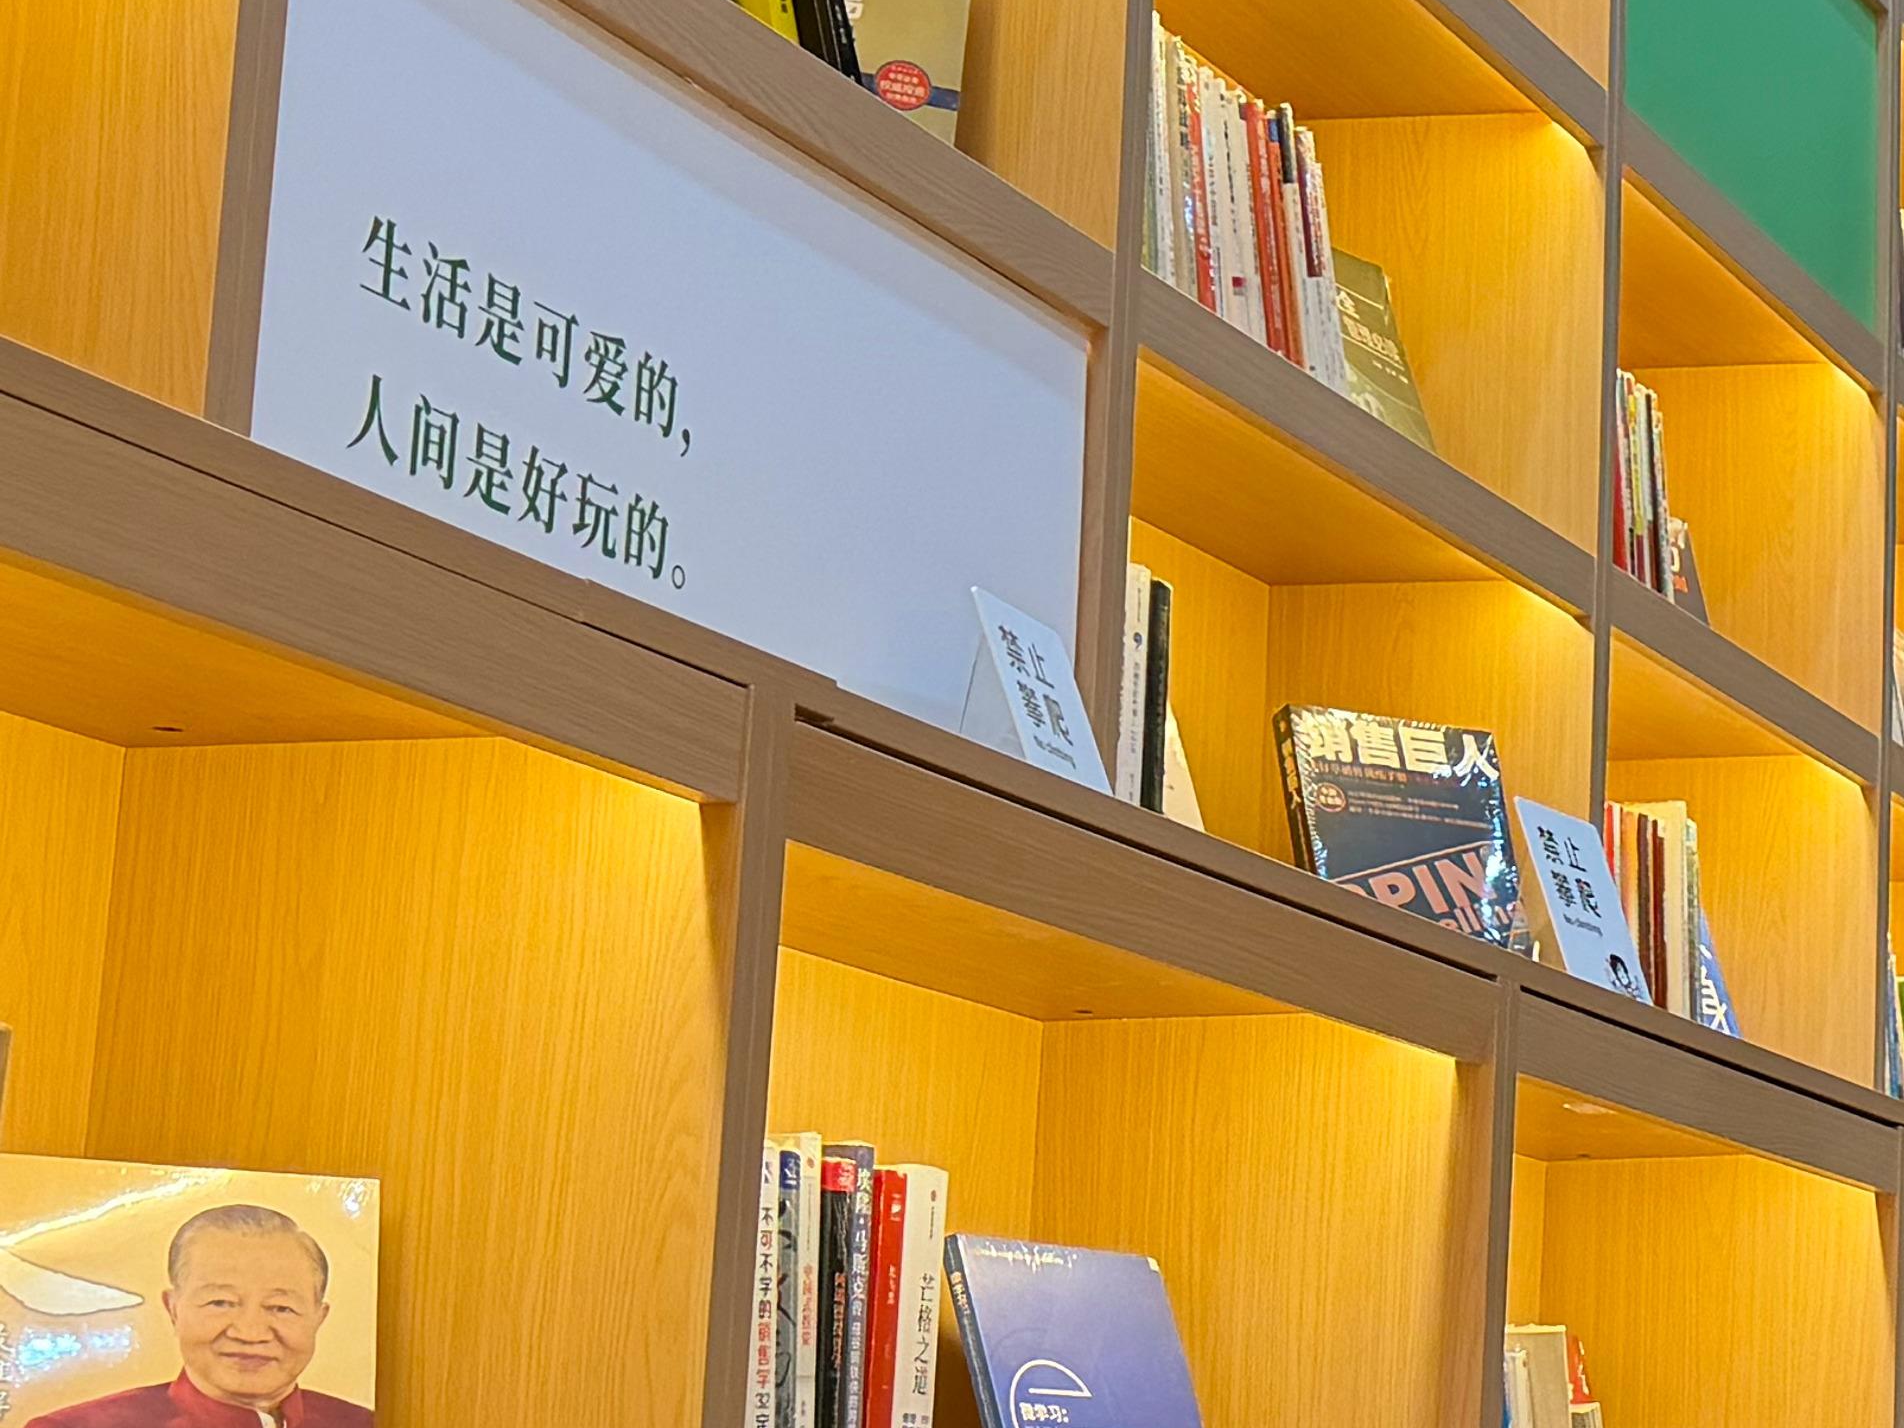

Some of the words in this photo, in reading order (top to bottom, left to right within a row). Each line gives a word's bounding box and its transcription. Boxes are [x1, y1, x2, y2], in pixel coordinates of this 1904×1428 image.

[359, 214, 694, 458] 生活是可爱的，
[346, 373, 687, 591] 人间是好玩的。
[998, 624, 1055, 690] 禁止
[1016, 679, 1074, 748] 攀爬
[1303, 715, 1500, 783] 销售巨人
[1537, 825, 1588, 873] 禁止
[1551, 869, 1603, 919] 攀爬
[911, 1272, 937, 1397] 芒格之道
